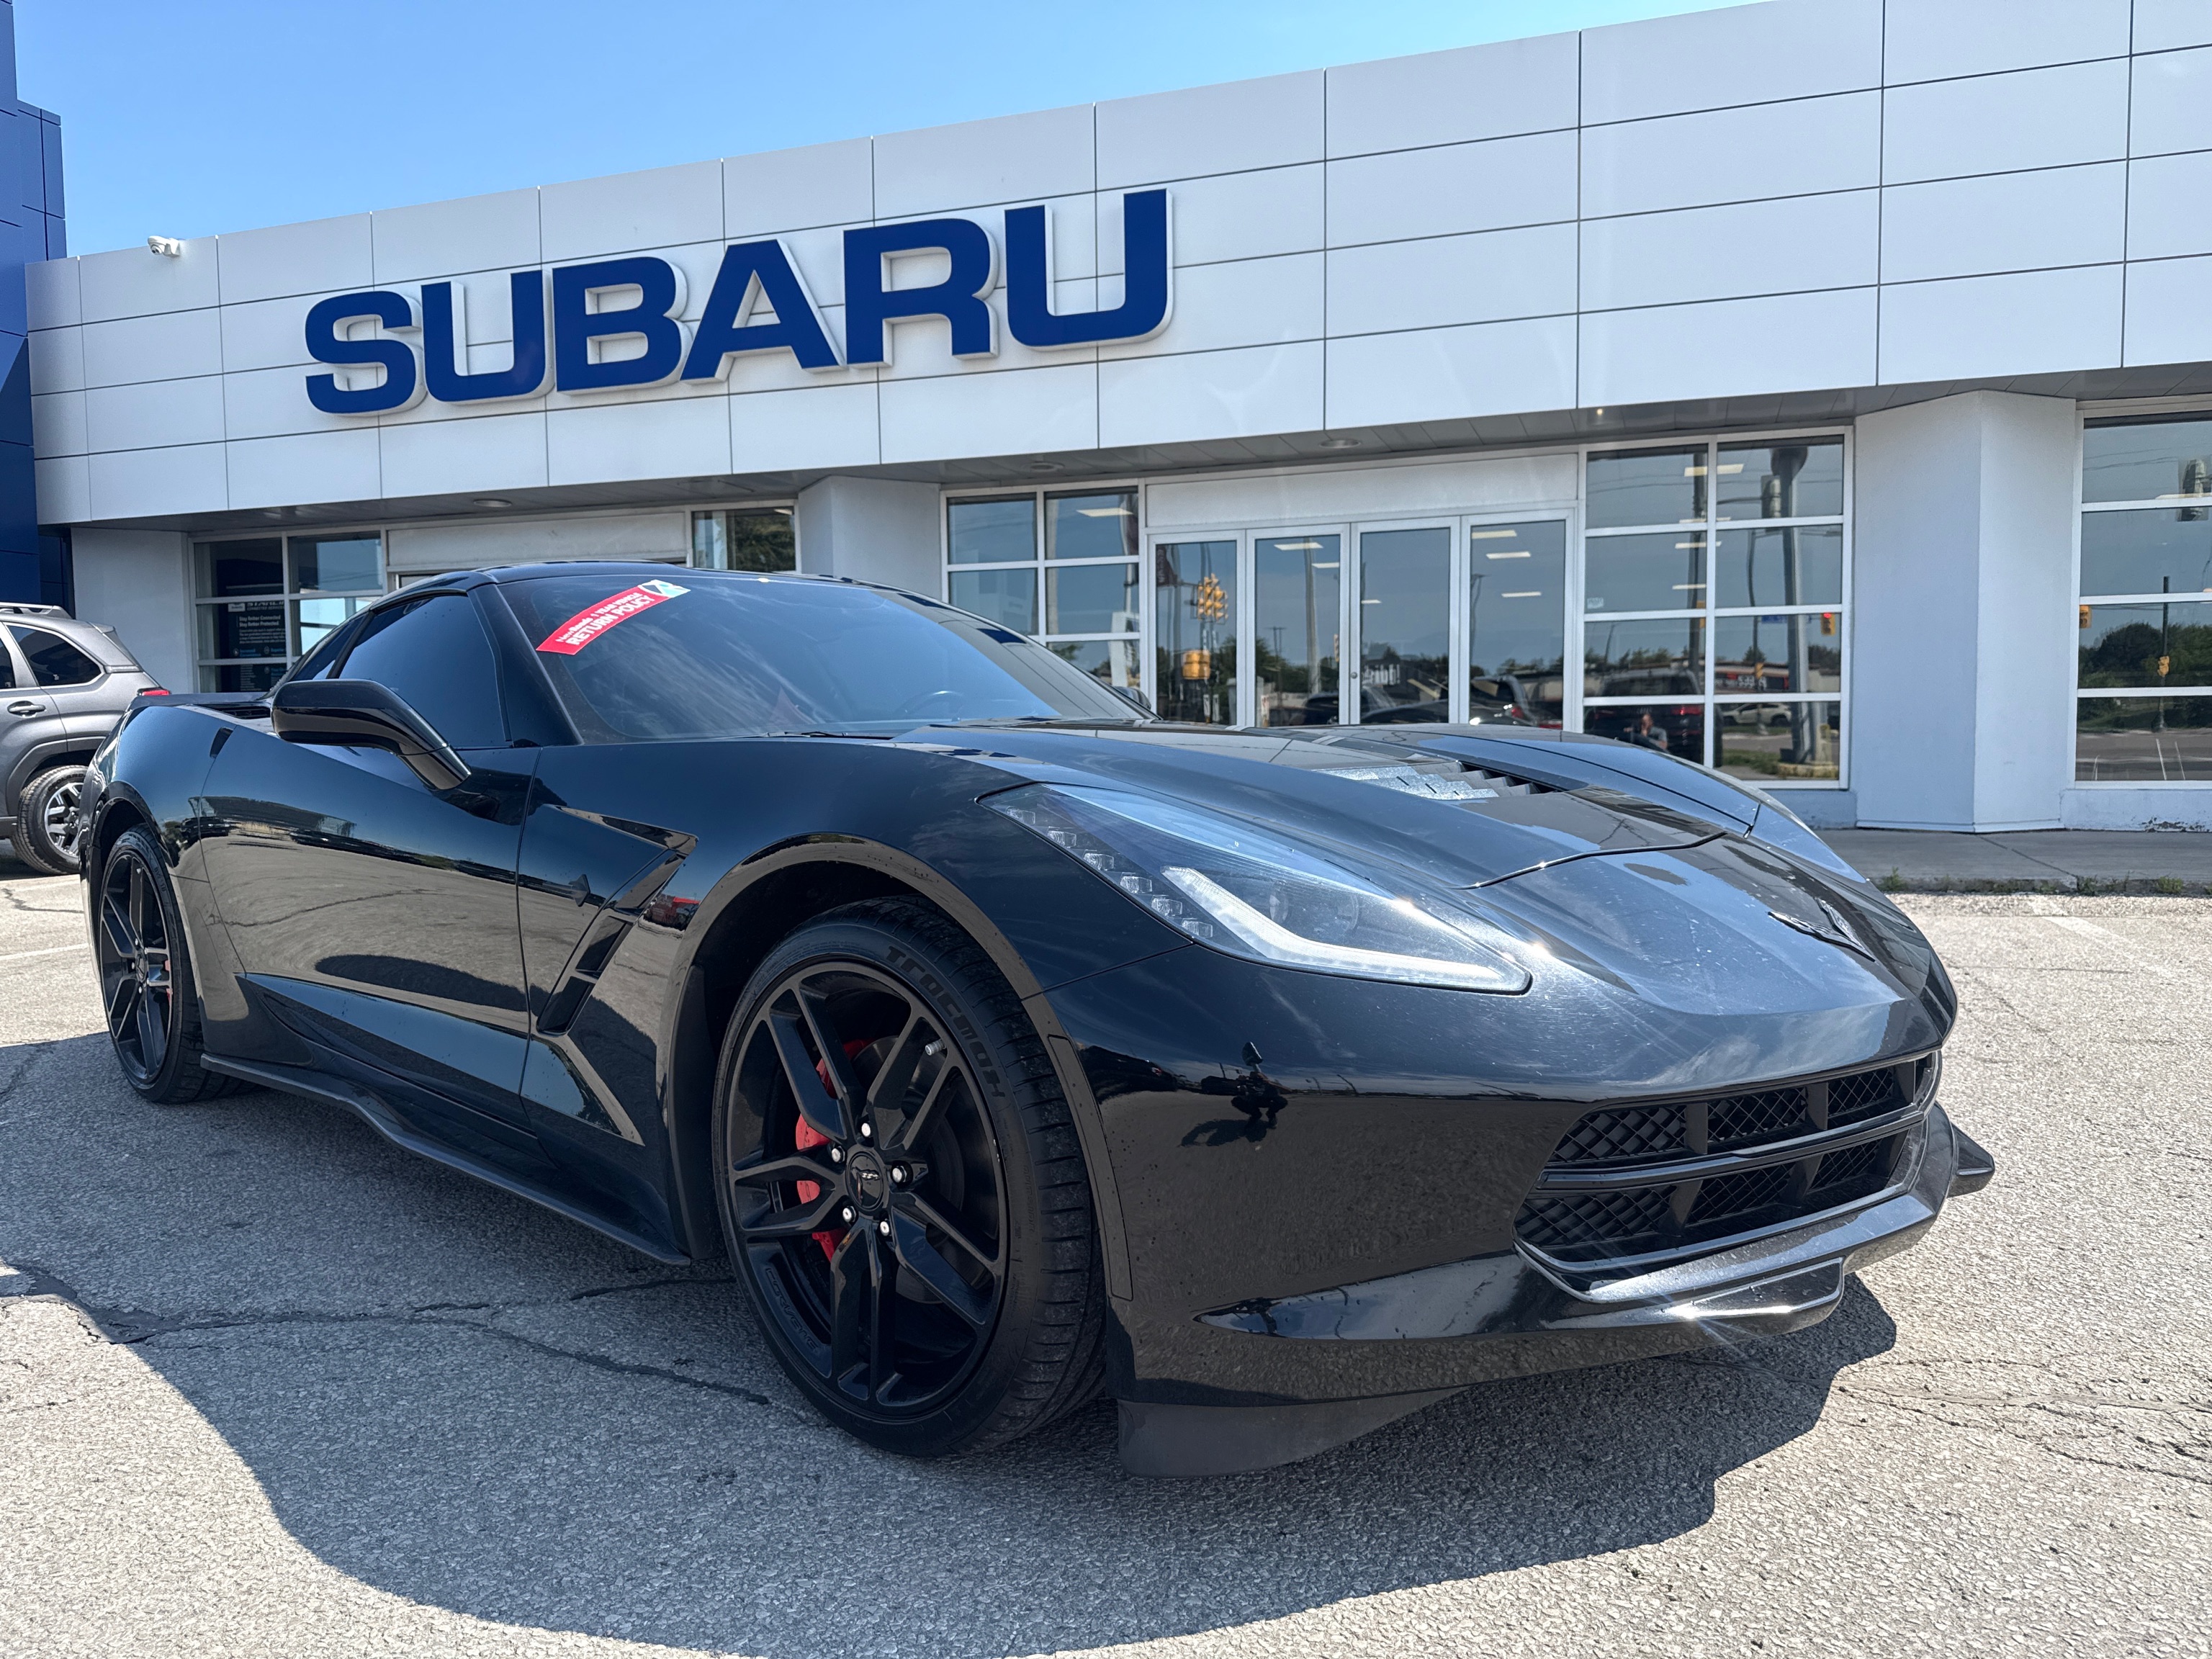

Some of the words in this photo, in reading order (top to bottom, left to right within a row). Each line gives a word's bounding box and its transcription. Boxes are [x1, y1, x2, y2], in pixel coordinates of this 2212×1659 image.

[305, 189, 1172, 416] SUBARU
[565, 613, 619, 645] RETURN
[611, 595, 655, 616] POLICY
[595, 603, 616, 614] YEAR
[613, 592, 643, 606] VEHICLE
